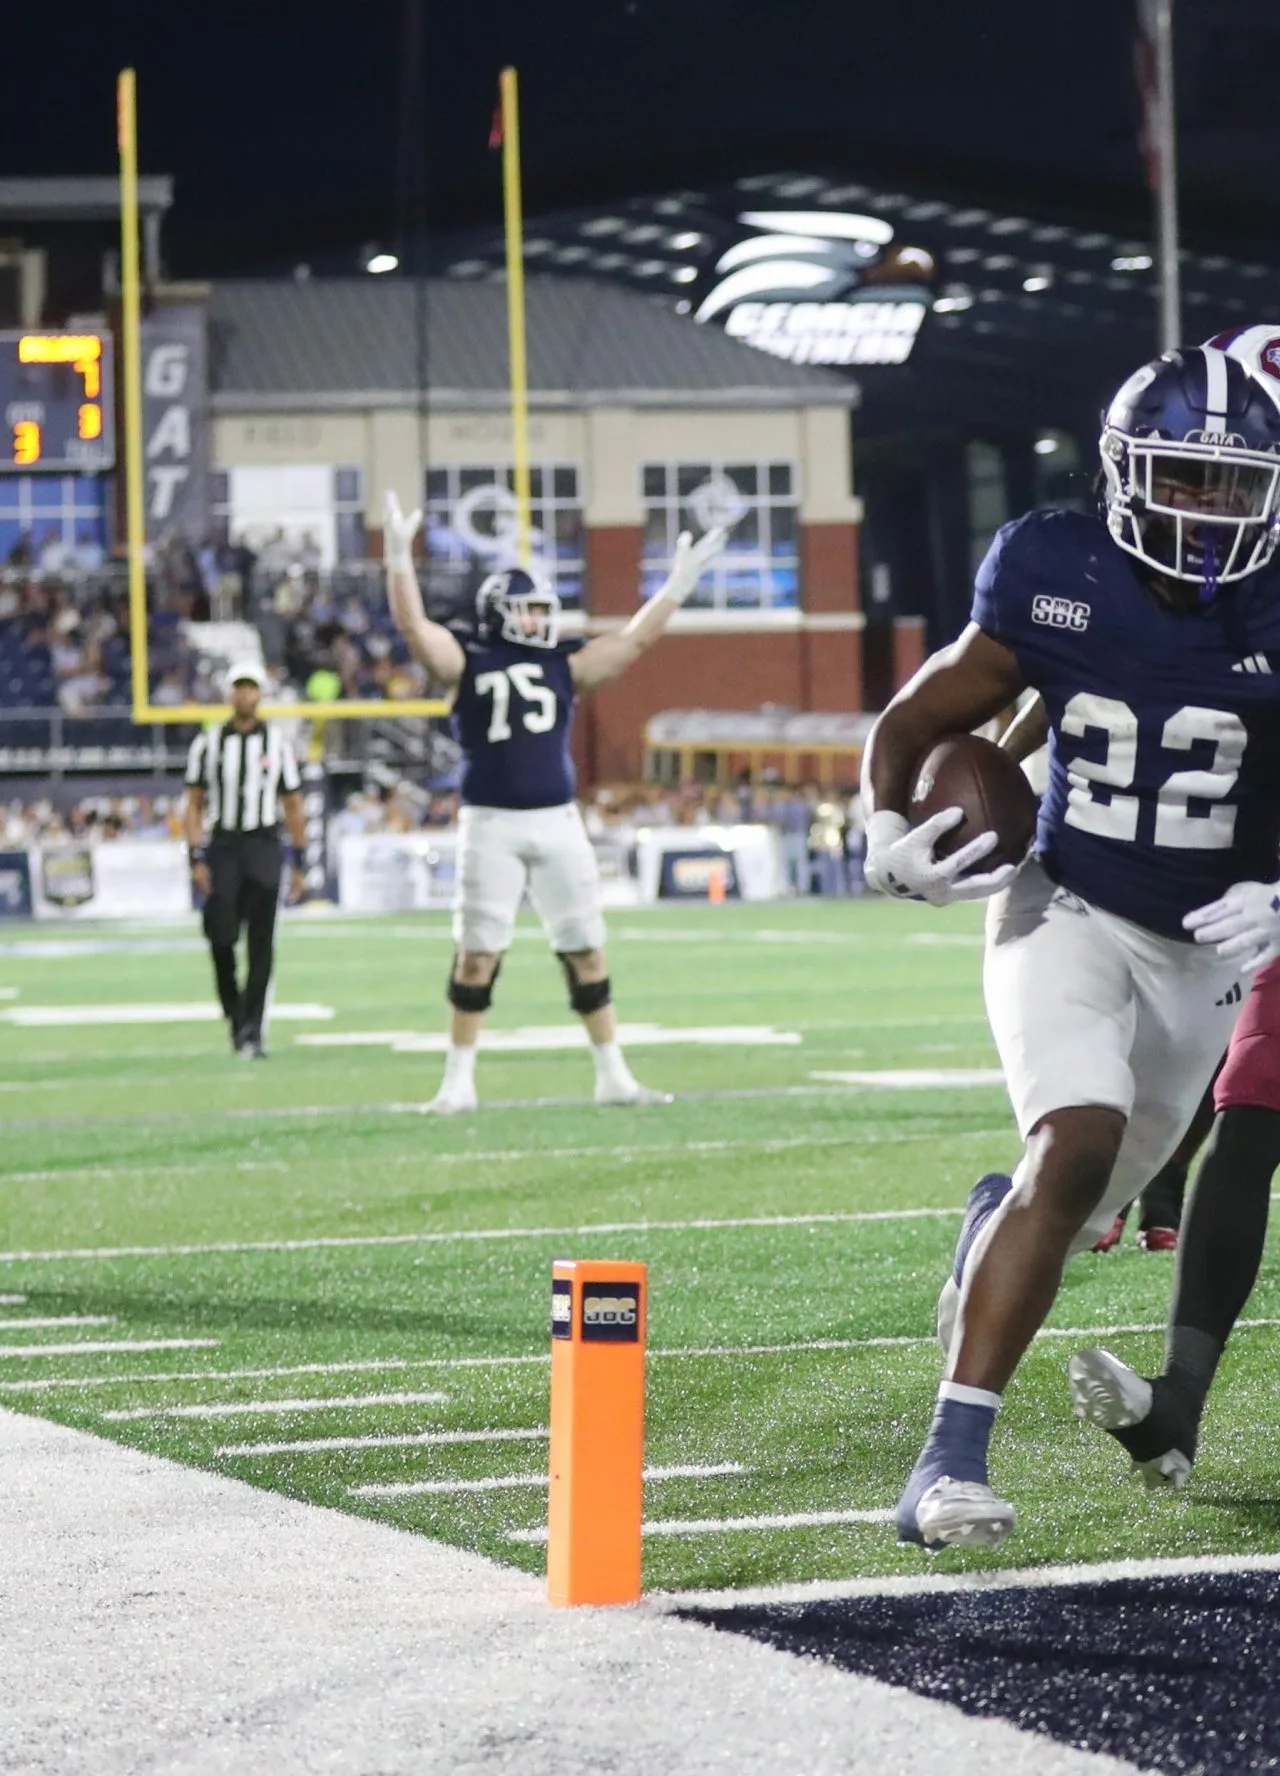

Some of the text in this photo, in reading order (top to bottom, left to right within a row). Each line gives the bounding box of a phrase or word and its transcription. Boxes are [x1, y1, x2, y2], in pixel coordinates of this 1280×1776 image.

[1200, 431, 1234, 446] GATA
[1031, 594, 1091, 632] SBC
[474, 662, 557, 743] 75
[1060, 691, 1248, 849] 22
